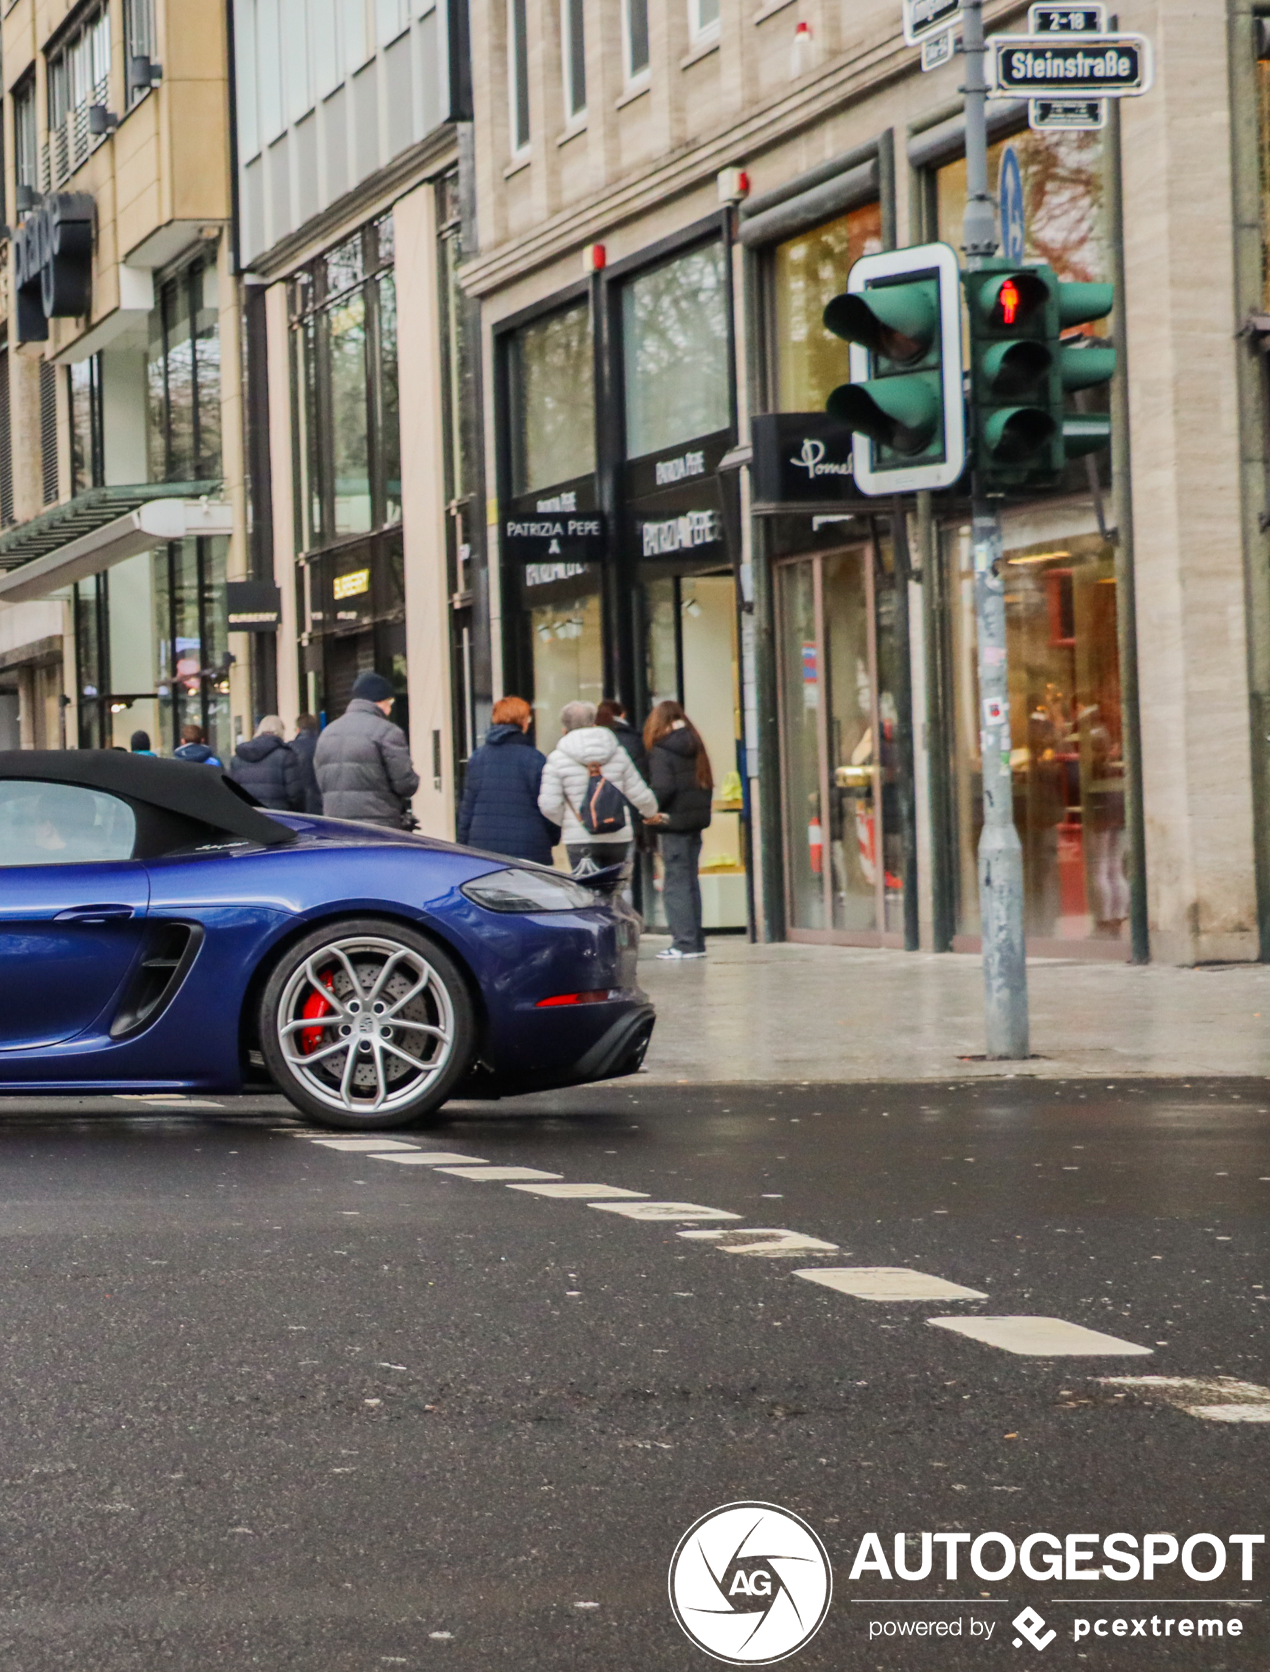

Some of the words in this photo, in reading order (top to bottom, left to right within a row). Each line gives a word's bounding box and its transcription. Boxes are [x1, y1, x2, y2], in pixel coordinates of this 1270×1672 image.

[1049, 13, 1085, 31] 2-18
[1011, 50, 1131, 79] Steinstraße
[507, 521, 564, 537] PATRIZIA
[568, 519, 601, 536] PEPE
